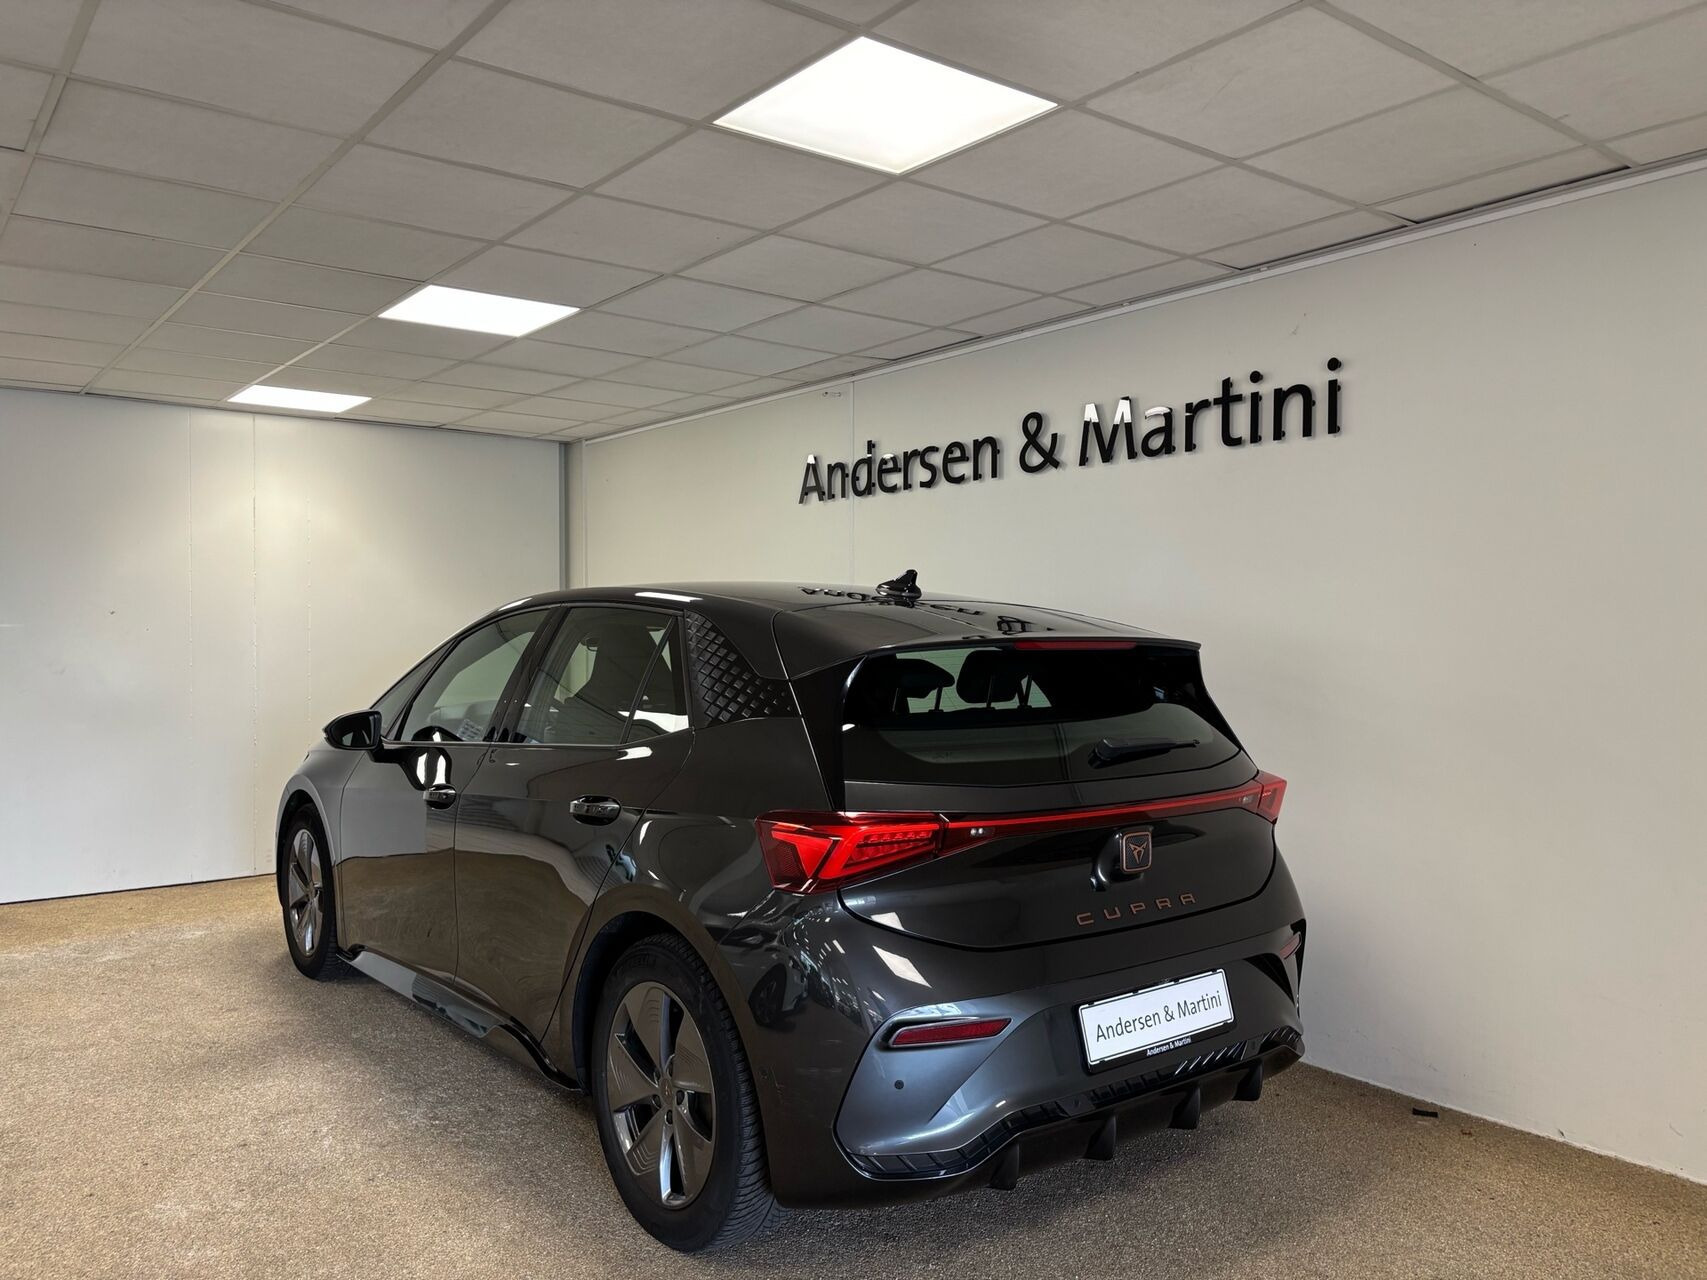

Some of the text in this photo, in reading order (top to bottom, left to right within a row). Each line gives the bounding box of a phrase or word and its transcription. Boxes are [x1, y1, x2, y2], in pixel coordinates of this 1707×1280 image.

[798, 357, 1343, 505] Andersen & Martini
[1076, 893, 1196, 926] CUPRA
[1096, 990, 1223, 1042] Andersen & Martini
[1146, 1045, 1169, 1056] Andersen
[1174, 1036, 1191, 1048] Martini
